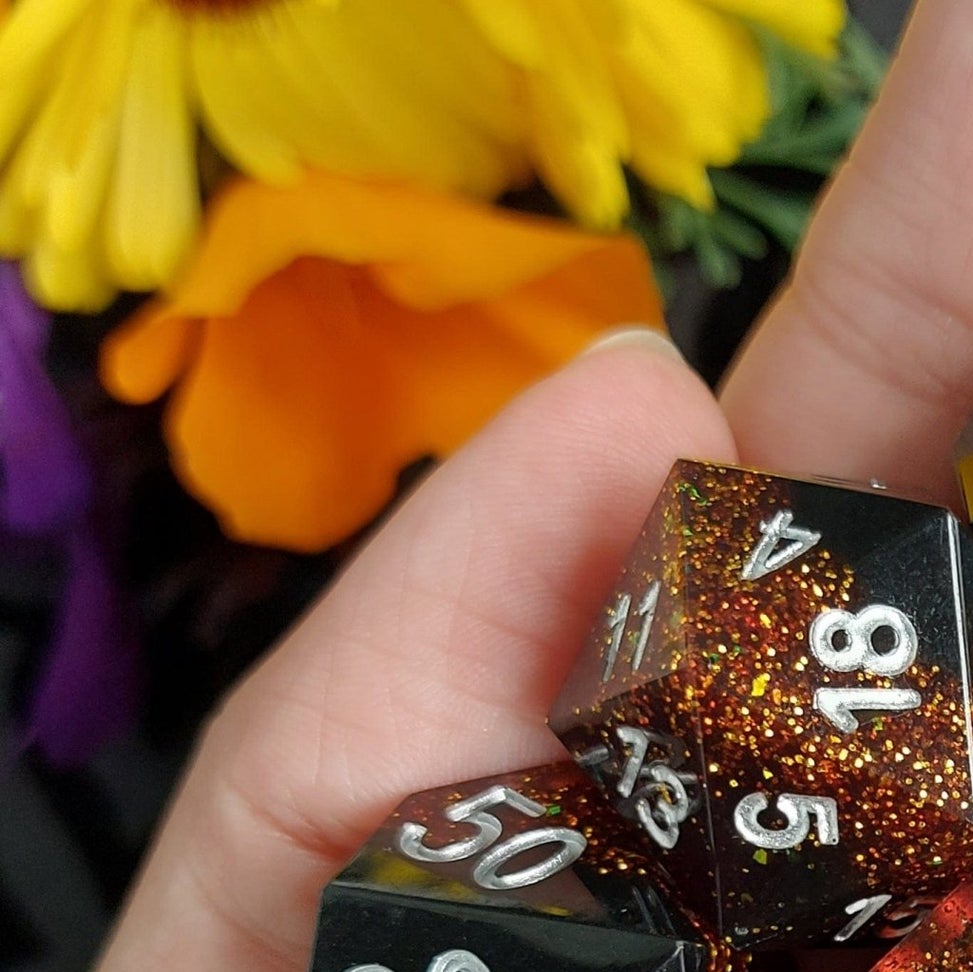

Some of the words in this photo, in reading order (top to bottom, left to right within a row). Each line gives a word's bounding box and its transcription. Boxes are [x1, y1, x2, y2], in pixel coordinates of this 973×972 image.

[741, 510, 822, 582] 4
[603, 581, 661, 682] 11
[809, 604, 922, 734] 18
[400, 785, 588, 890] 50
[733, 792, 839, 850] 5
